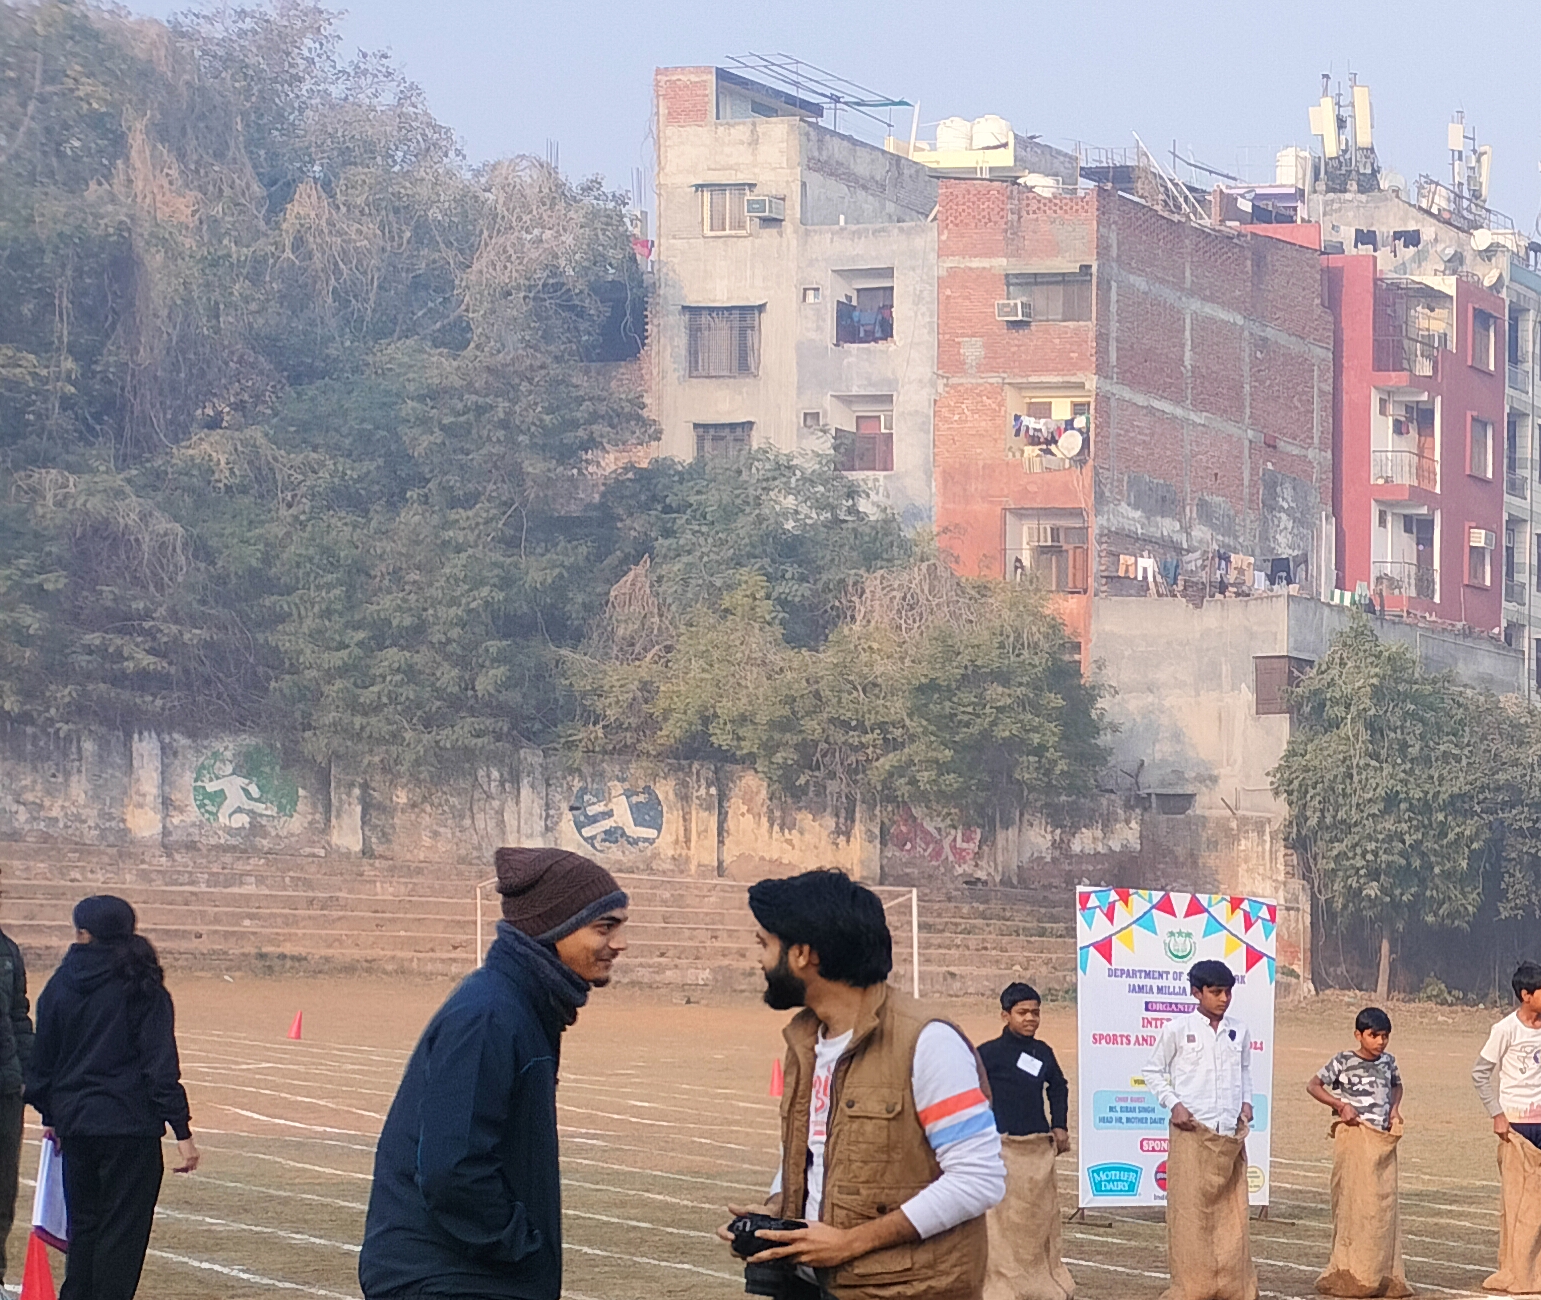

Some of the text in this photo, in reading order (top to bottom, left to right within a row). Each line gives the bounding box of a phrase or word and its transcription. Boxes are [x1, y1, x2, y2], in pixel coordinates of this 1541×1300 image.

[1108, 968, 1170, 981] DEPARTMENT
[1172, 971, 1184, 982] OF
[1128, 984, 1154, 995] JAMIA
[1156, 985, 1187, 997] MILLIA
[1147, 1002, 1197, 1013] ORGANIZ
[1141, 1017, 1172, 1029] INTE
[1091, 1033, 1131, 1046] SPORTS
[1133, 1035, 1156, 1047] AND
[1093, 1170, 1137, 1183] MOTHER
[1101, 1181, 1130, 1191] DAIRY
